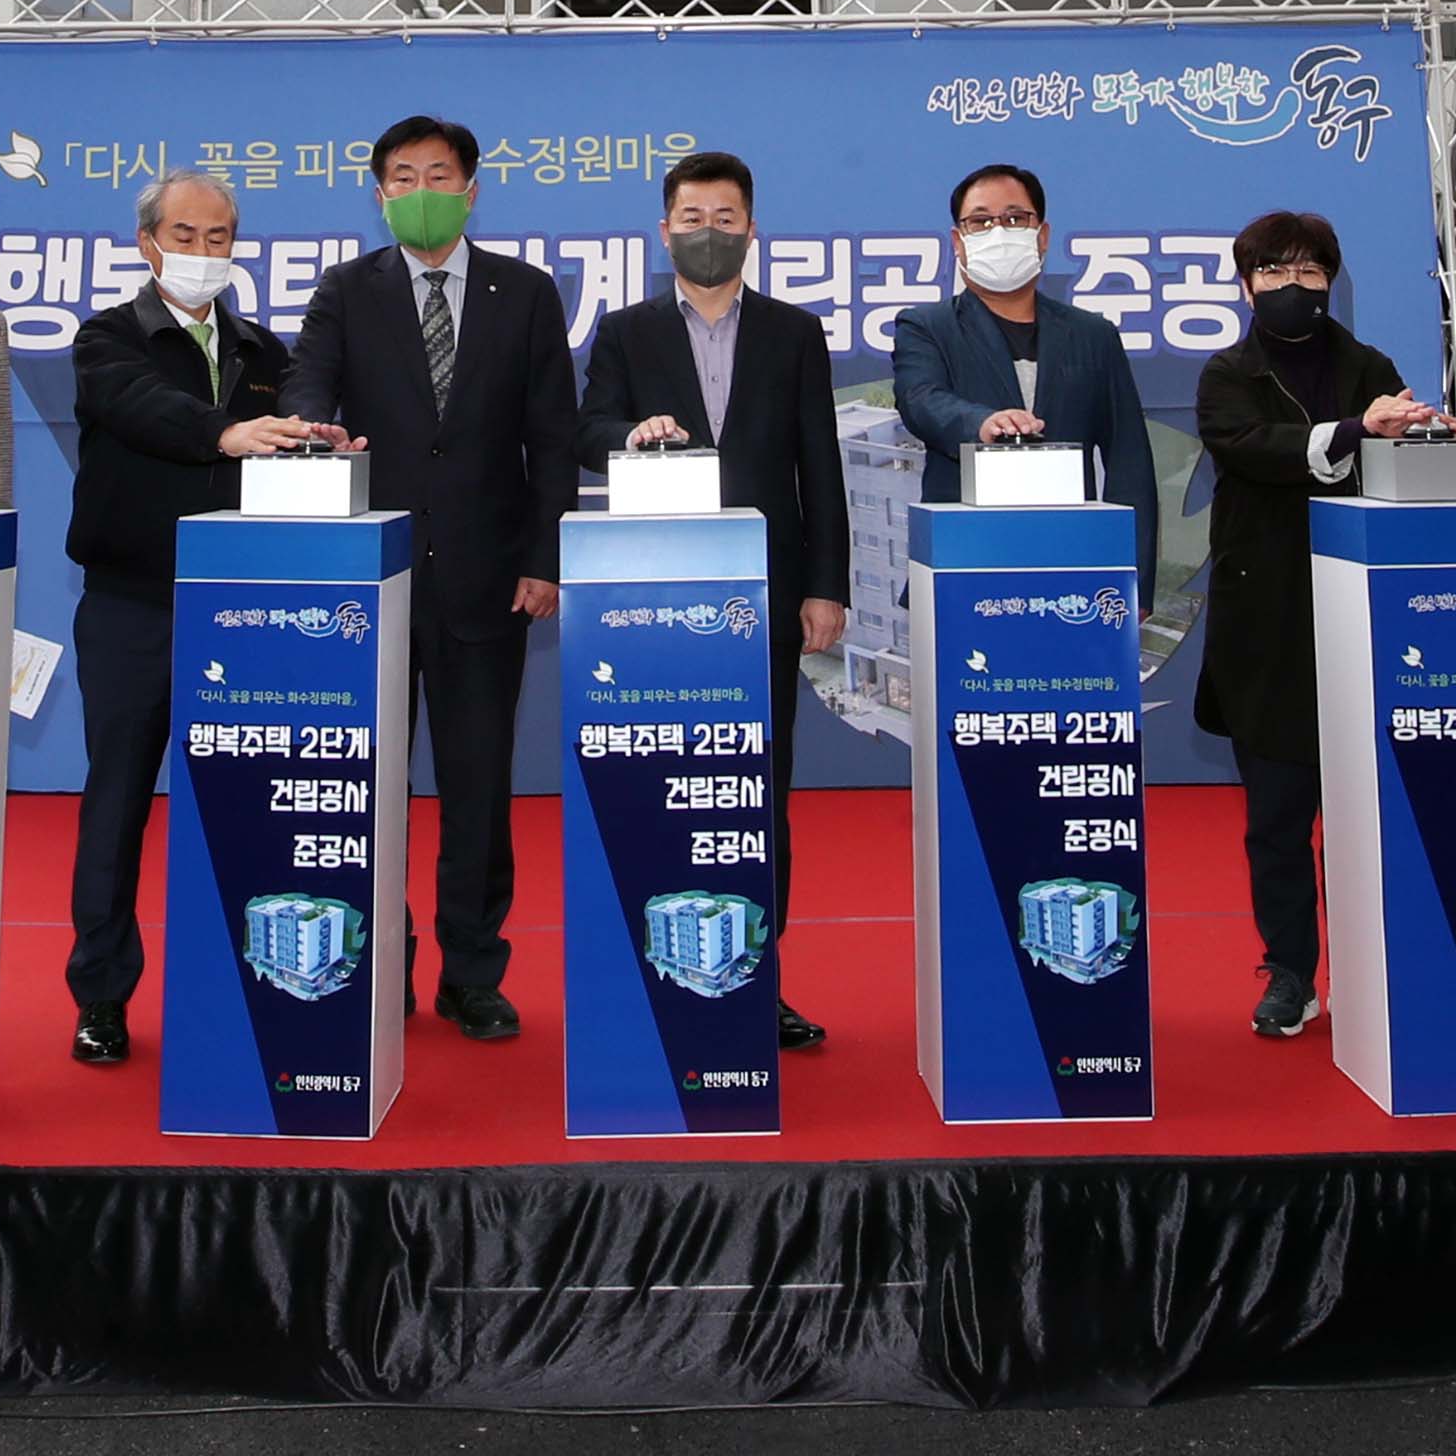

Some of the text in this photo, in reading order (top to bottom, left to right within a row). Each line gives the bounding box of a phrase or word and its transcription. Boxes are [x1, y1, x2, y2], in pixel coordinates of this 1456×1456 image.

[927, 44, 1392, 162] 새로운 변화 모두가 행복한 동구
[195, 141, 284, 189] 꽃을
[294, 140, 374, 187] 피우
[1071, 236, 1240, 350] 준공
[188, 723, 370, 760] 행복주택 2단계
[580, 722, 764, 758] 행복주택 2단계
[954, 710, 1135, 746] 행복주택 2단계
[269, 779, 369, 814] 건립공사
[665, 776, 765, 810] 건립공사
[1038, 764, 1136, 797] 건립공사
[293, 834, 367, 869] 준공식
[691, 830, 766, 865] 준공식
[1064, 818, 1137, 853] 준공식
